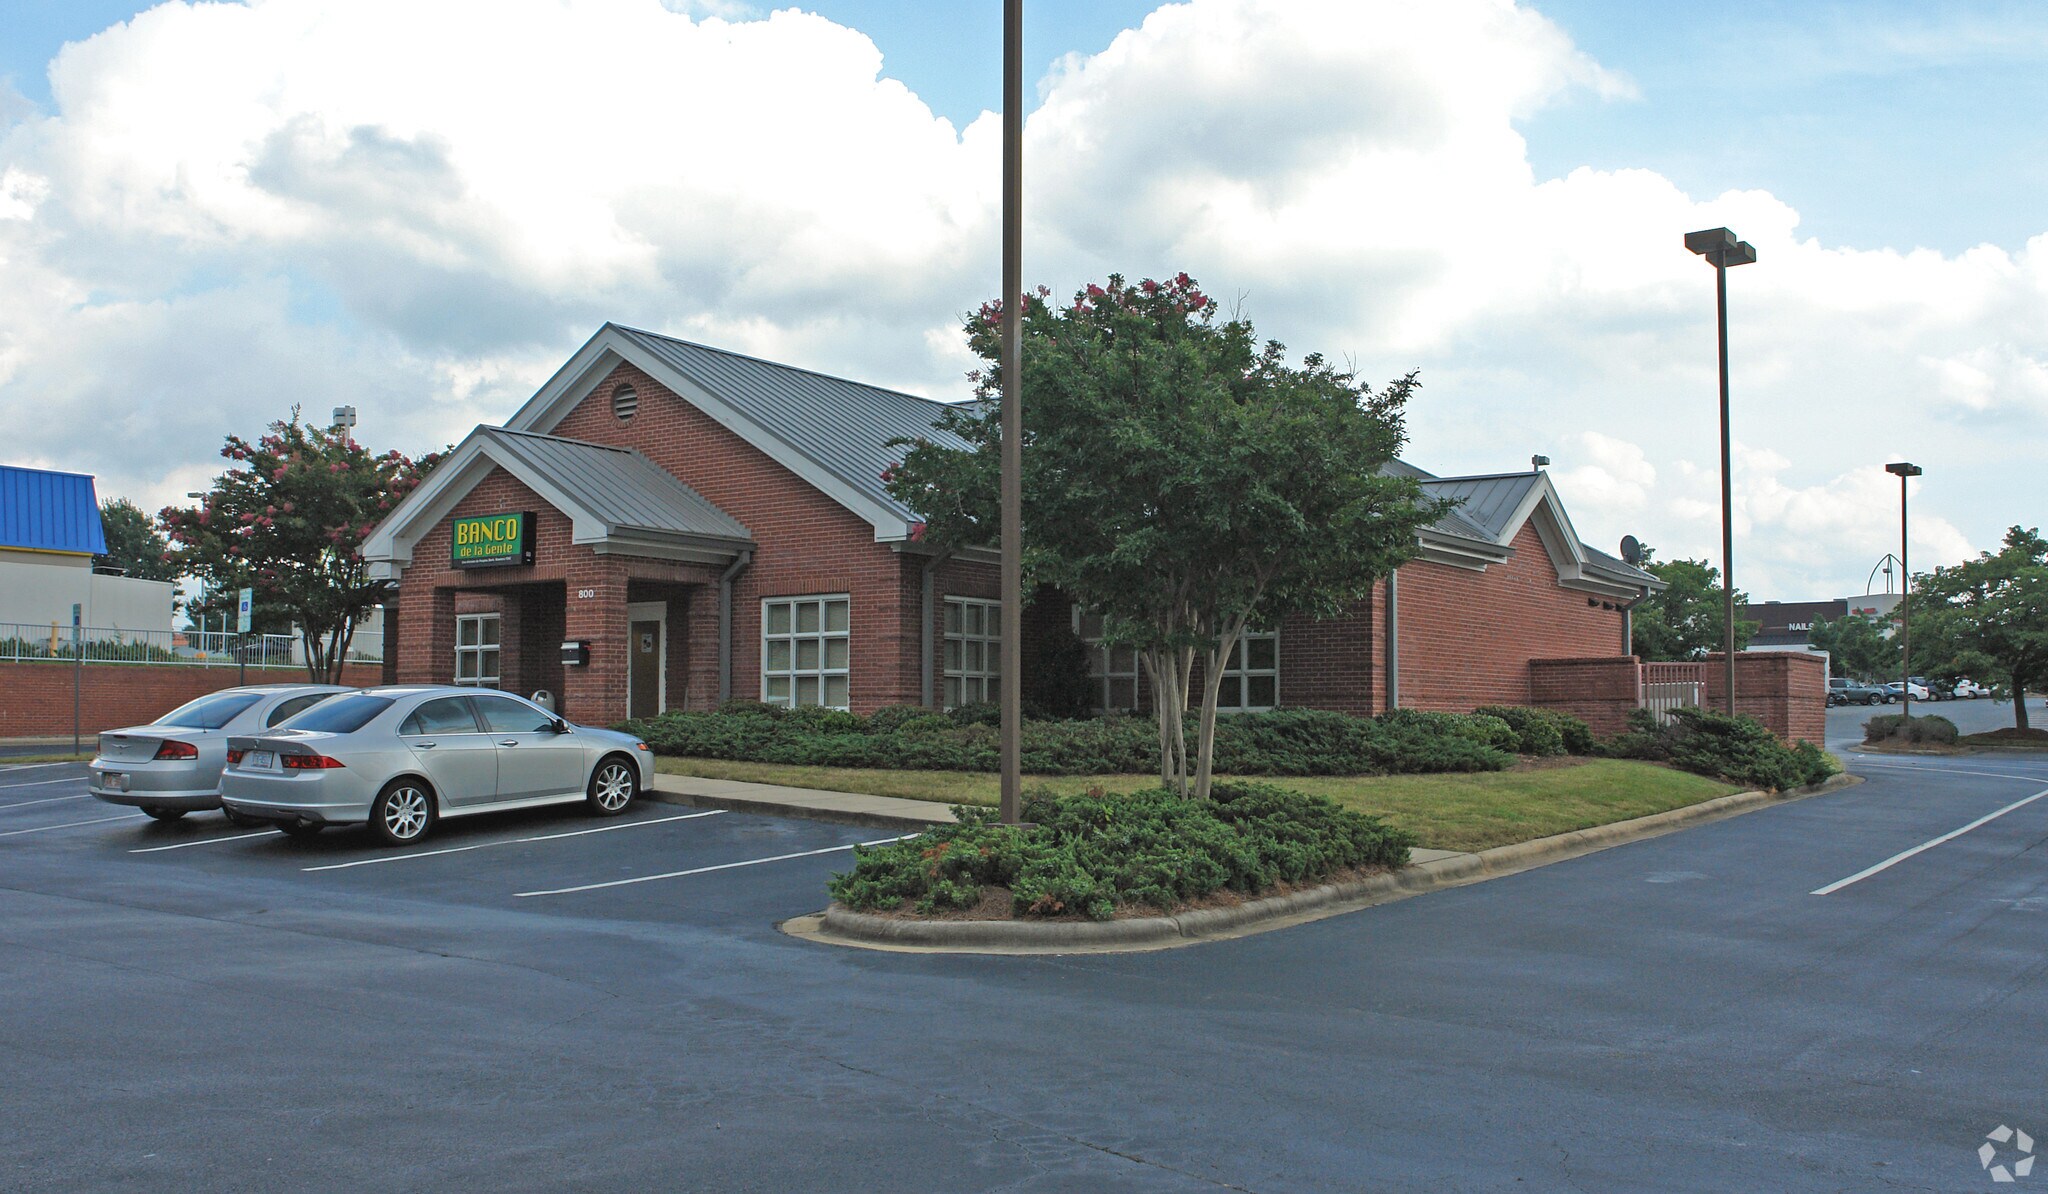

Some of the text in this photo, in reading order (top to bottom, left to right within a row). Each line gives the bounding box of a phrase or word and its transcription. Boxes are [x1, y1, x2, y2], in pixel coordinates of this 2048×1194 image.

[457, 518, 517, 545] BANCO
[460, 542, 513, 557] de la Gente
[578, 589, 594, 599] 800
[1788, 622, 1814, 631] NAILS
